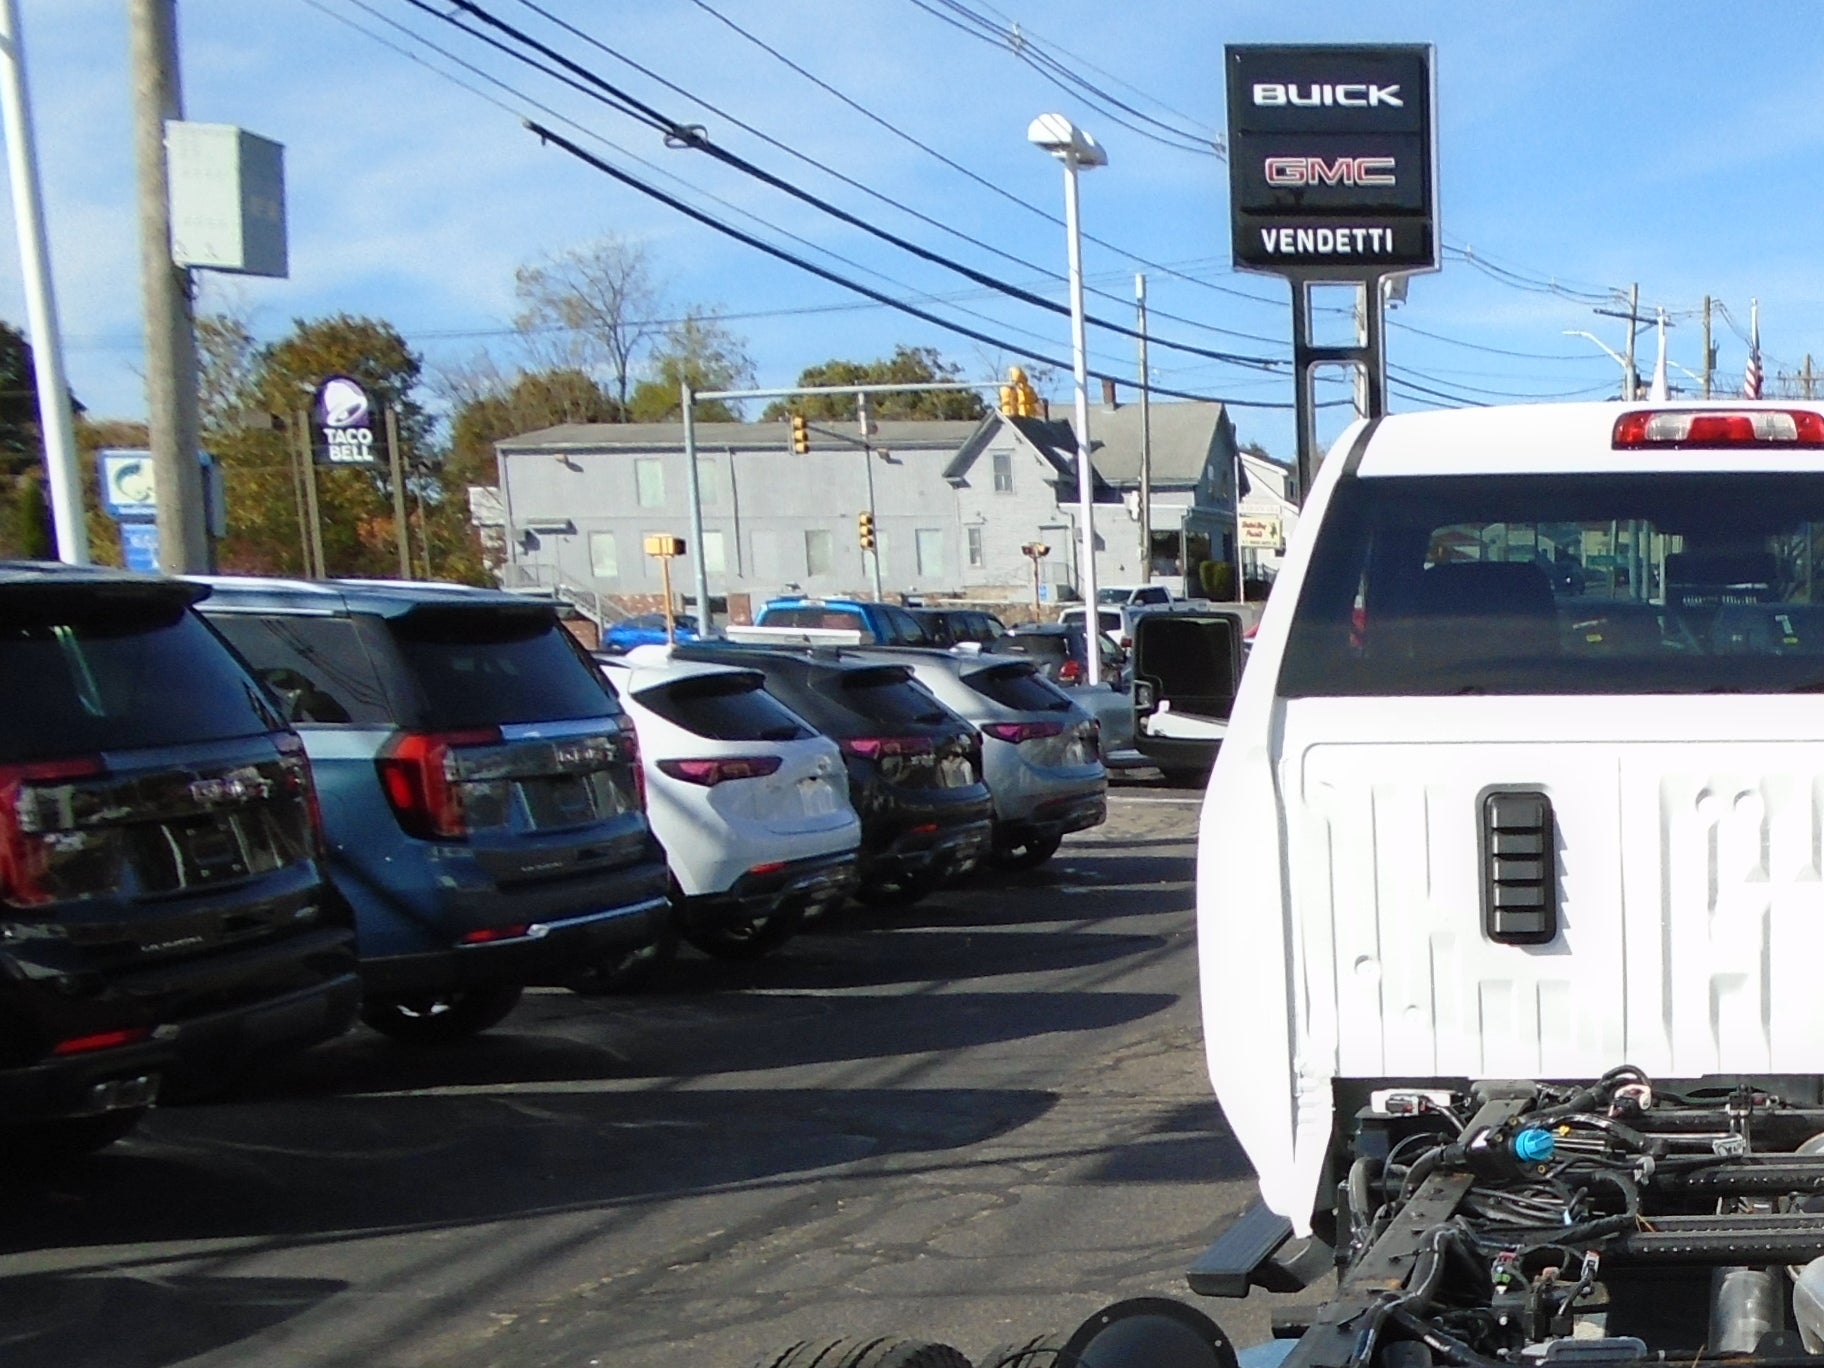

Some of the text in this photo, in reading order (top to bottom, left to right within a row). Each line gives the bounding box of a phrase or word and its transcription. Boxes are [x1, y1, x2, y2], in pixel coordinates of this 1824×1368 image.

[1252, 83, 1404, 108] BUICK
[1264, 157, 1397, 188] GMC
[1261, 228, 1393, 253] VENDETTI
[323, 427, 374, 446] TACO
[328, 444, 375, 462] BELL
